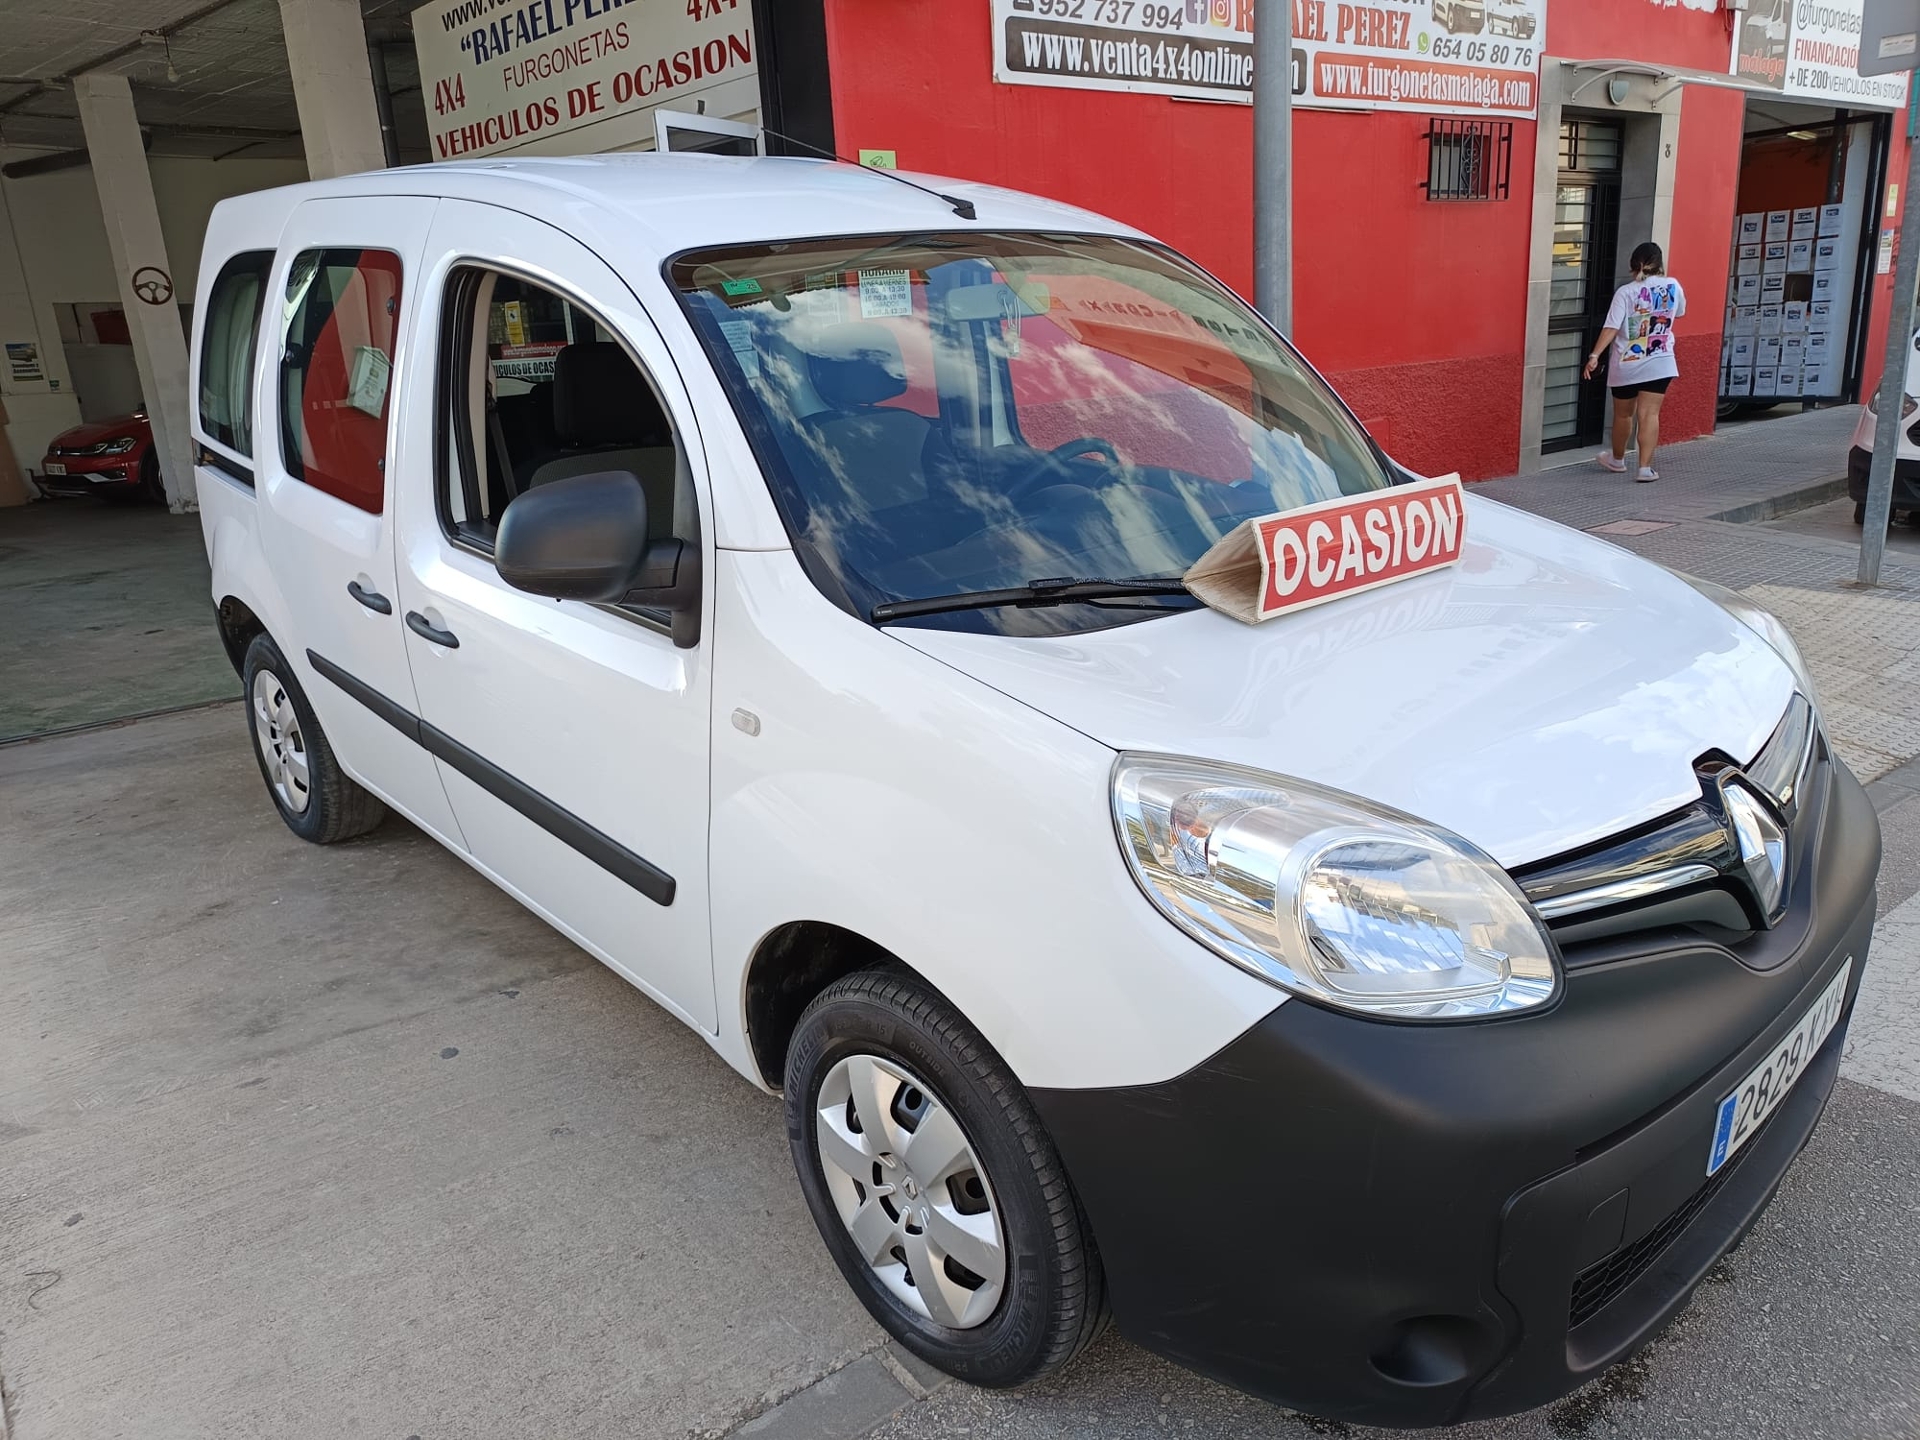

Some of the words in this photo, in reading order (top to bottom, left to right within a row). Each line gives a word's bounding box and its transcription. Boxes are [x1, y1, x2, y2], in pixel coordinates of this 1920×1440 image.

[1038, 0, 1083, 19] 952
[1094, 0, 1136, 25] 737
[1141, 4, 1183, 30] 994
[1235, 0, 1328, 42] RAEL
[1336, 4, 1411, 50] PEREZ
[503, 22, 630, 92] FURGONETAS
[1432, 37, 1462, 60] 654
[1466, 41, 1485, 62] 05
[1490, 44, 1509, 65] 80
[1514, 47, 1533, 67] 76
[434, 73, 466, 116] 4X4
[436, 97, 560, 158] VEHICULOS
[567, 81, 605, 120] DE
[612, 29, 752, 103] OCASION
[1321, 62, 1530, 108] www.furgonetasmalaga.com
[1797, 68, 1809, 87] DE
[1811, 70, 1829, 89] 200
[1873, 82, 1882, 97] EN
[1883, 83, 1907, 101] STOCK
[522, 362, 532, 374] DE
[534, 361, 556, 374] OCAS
[1273, 493, 1461, 597] OCASION
[1733, 1031, 1804, 1144] 2829
